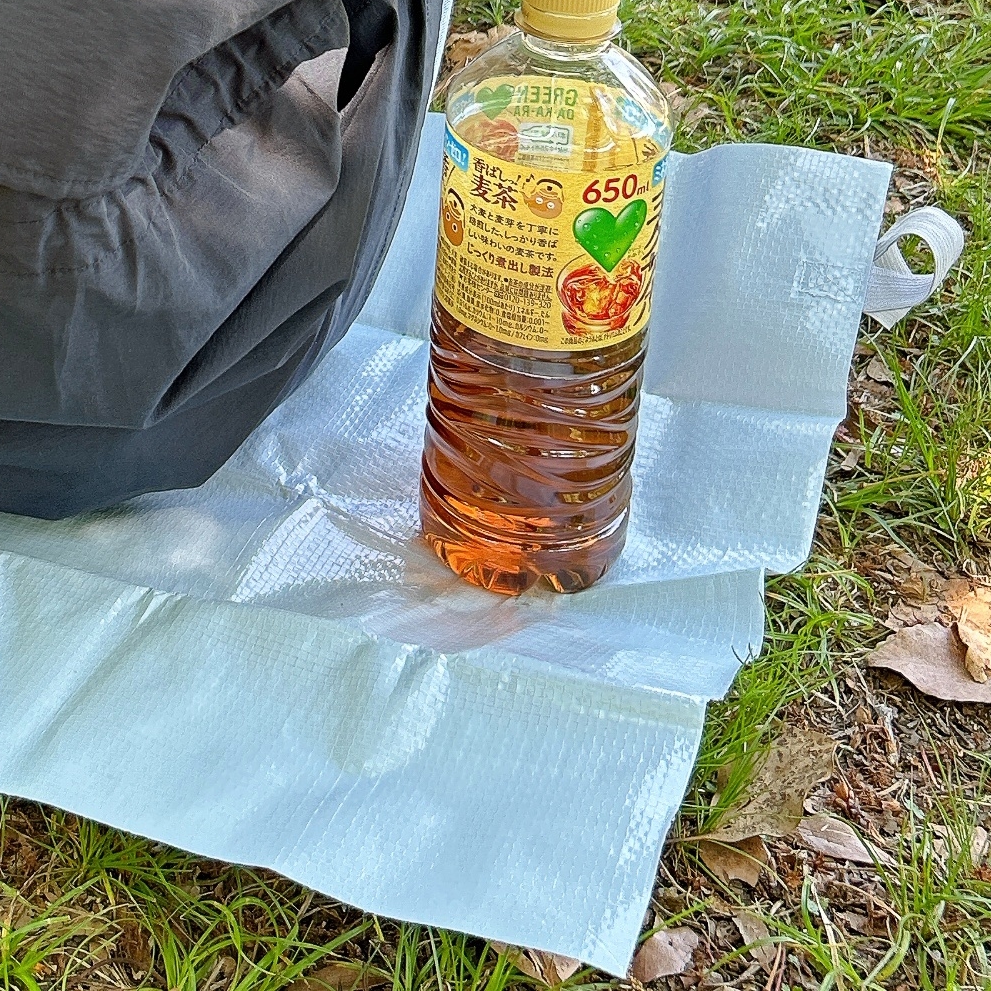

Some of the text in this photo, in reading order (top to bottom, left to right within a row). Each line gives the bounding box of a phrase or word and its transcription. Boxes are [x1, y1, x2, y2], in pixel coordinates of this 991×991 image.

[470, 173, 518, 211] 麦茶
[582, 173, 649, 204] 650ml
[468, 216, 558, 249] 焙煎した、しっかり香ば
[469, 203, 559, 236] 大麦と麦芽を丁寧に
[466, 241, 554, 279] じっくり煮出し製法
[467, 228, 557, 262] しい味わいの麦茶です。
